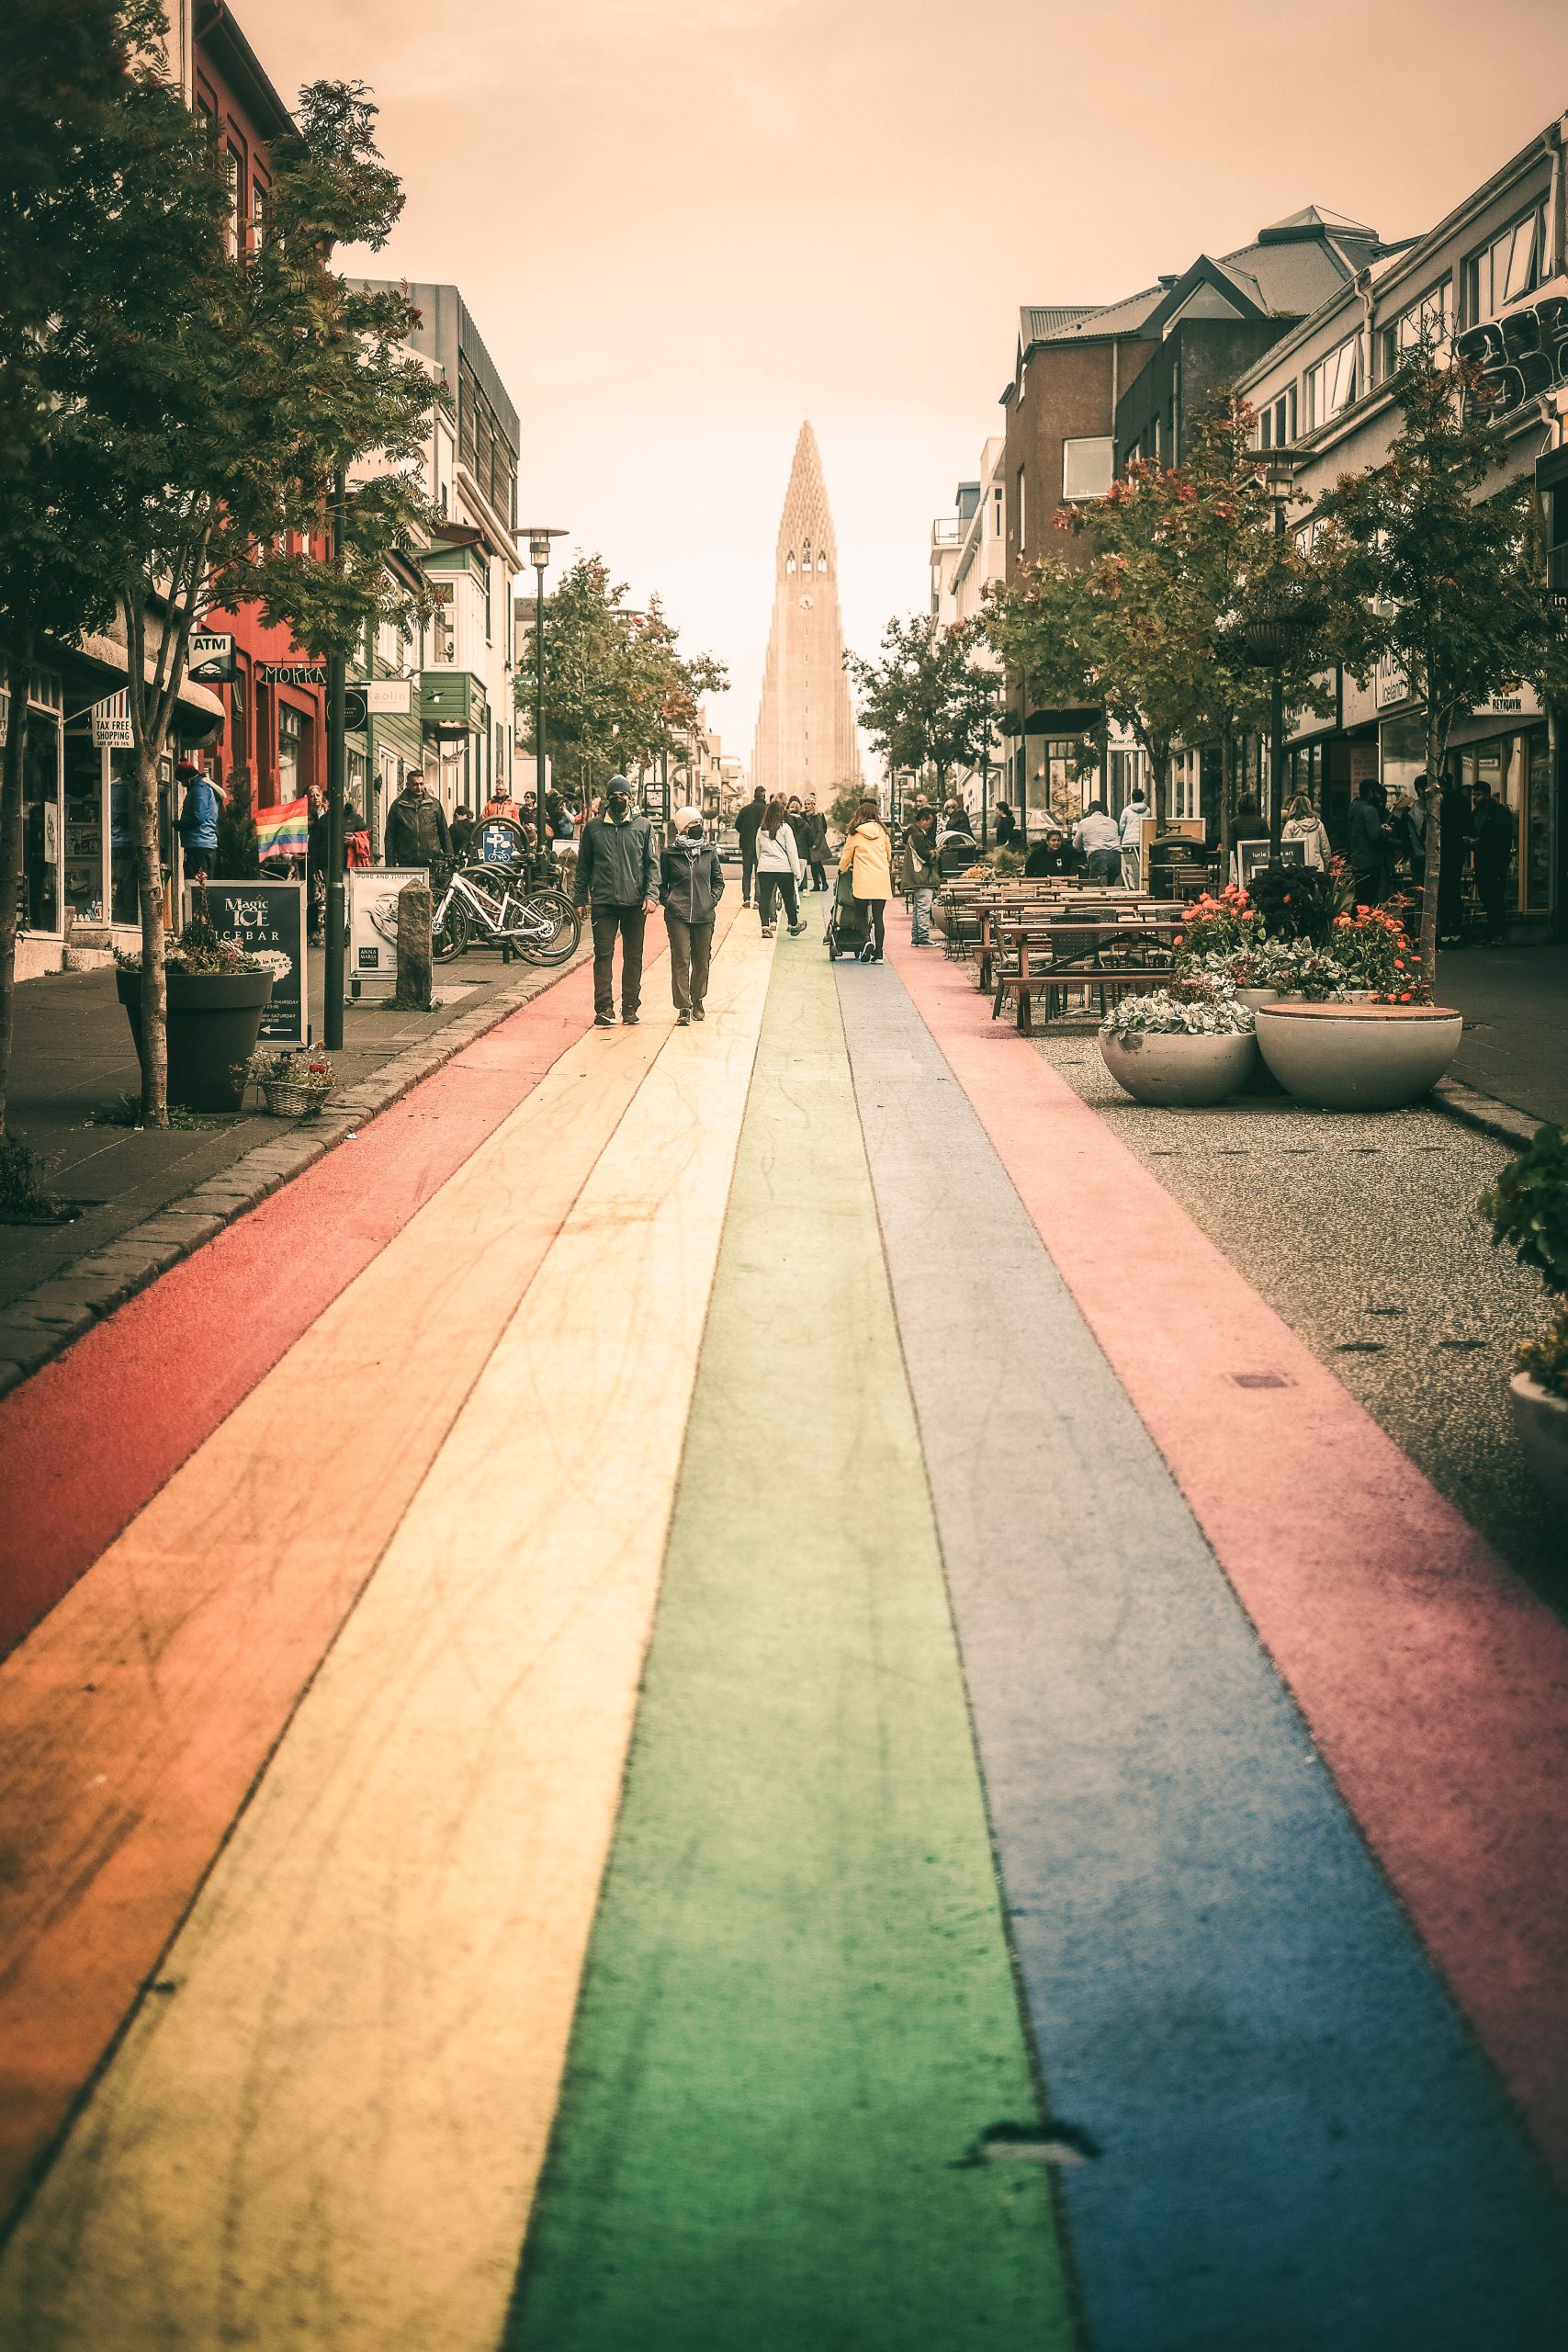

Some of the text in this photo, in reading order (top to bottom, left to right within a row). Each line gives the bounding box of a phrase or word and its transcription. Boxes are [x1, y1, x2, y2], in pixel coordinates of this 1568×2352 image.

[193, 638, 226, 650] ATM
[265, 667, 326, 684] MOKKA
[96, 721, 130, 730] TAX FREE
[96, 731, 130, 740] SHOPPING
[493, 833, 504, 848] P
[224, 898, 269, 912] Magic
[232, 909, 270, 927] ICE
